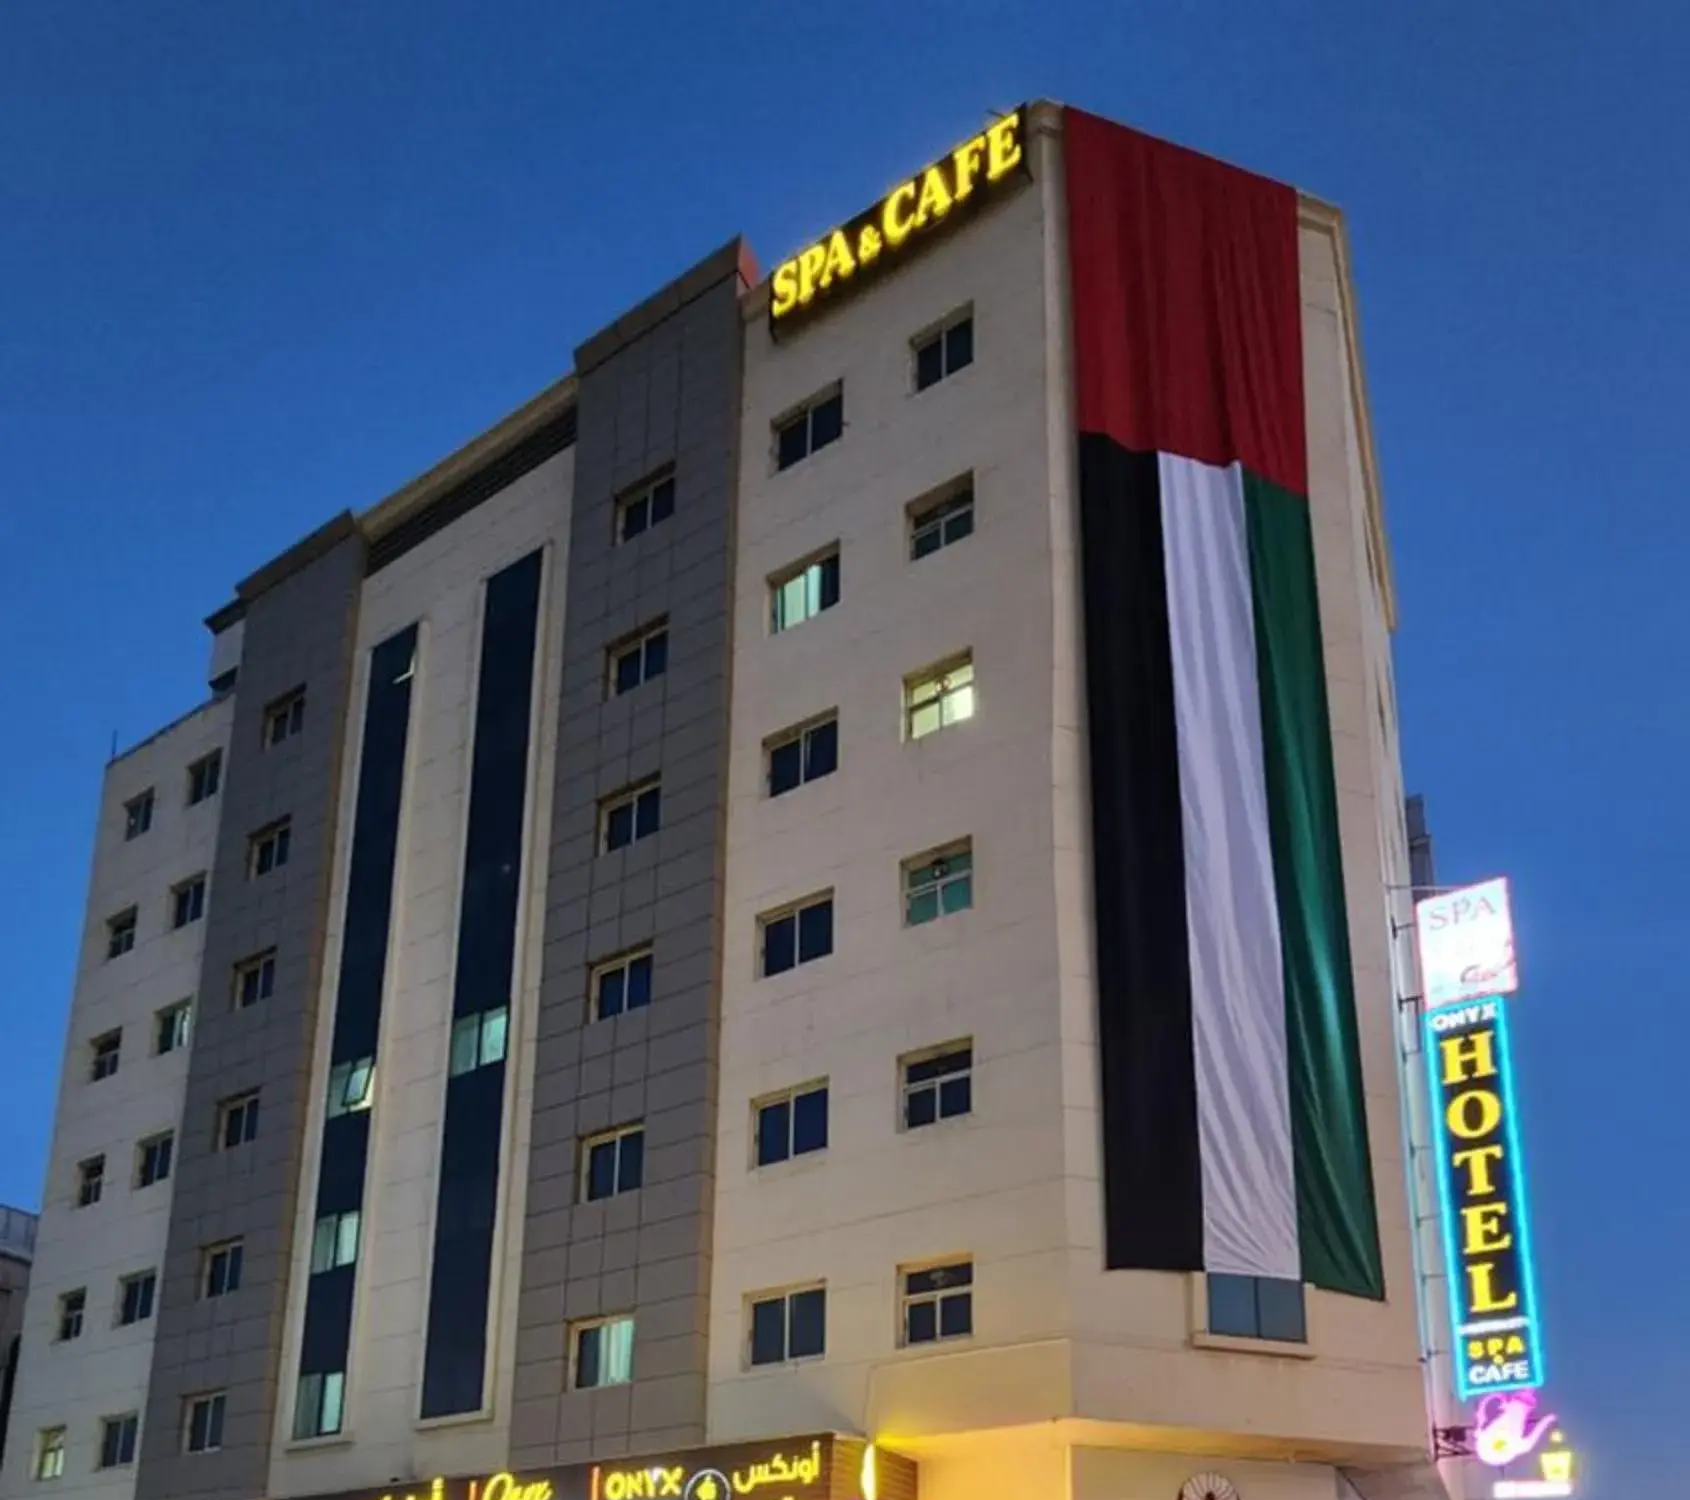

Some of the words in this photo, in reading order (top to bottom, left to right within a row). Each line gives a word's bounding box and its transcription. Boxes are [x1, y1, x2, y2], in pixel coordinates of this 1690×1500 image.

[772, 230, 856, 318] SPA
[858, 224, 883, 264] &
[882, 112, 1022, 246] CAFE
[1428, 895, 1498, 932] SPA
[1430, 1000, 1497, 1032] ONYX
[1439, 1030, 1518, 1314] HOTEL
[1467, 1335, 1525, 1359] SPA
[1468, 1359, 1530, 1385] CAFE
